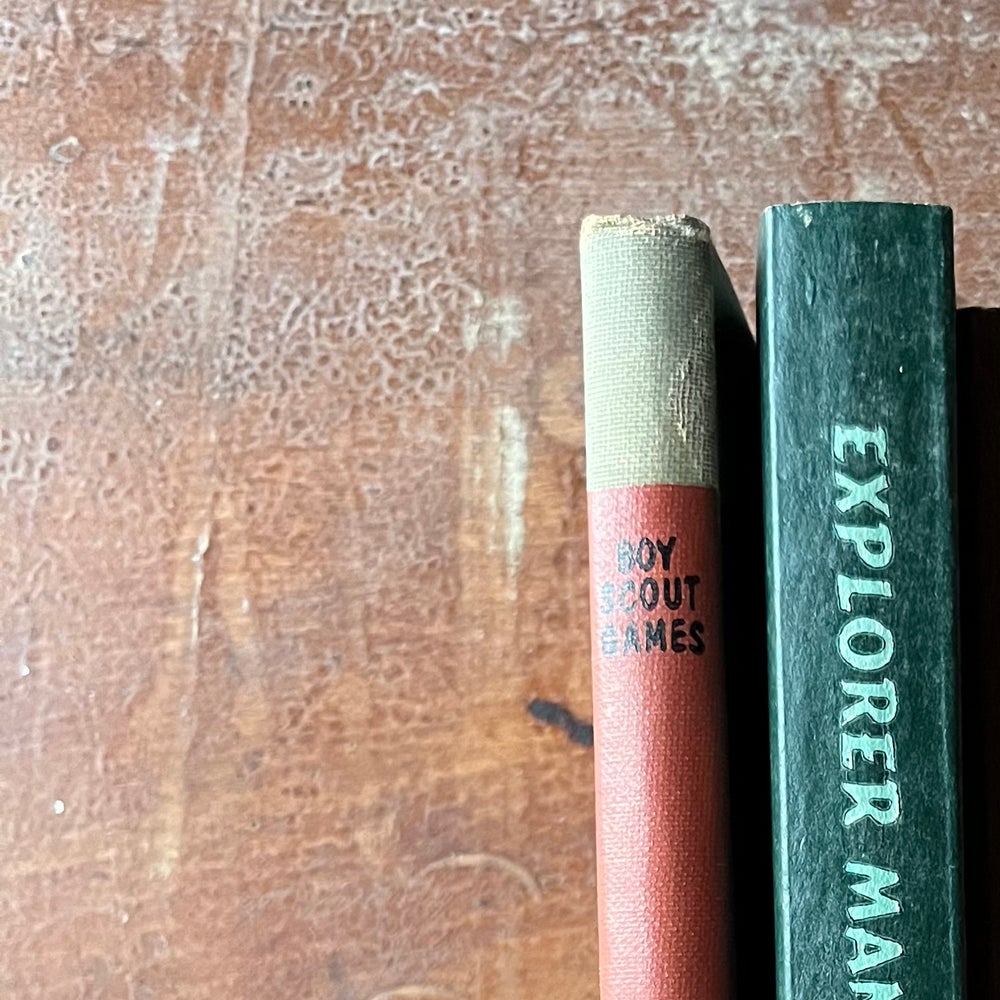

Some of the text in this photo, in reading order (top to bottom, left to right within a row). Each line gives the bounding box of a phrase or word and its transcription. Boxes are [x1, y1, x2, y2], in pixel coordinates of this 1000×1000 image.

[617, 536, 677, 574] BOY
[601, 575, 700, 614] SCOUT
[602, 618, 706, 656] GAMES
[834, 424, 900, 826] EXPLORER
